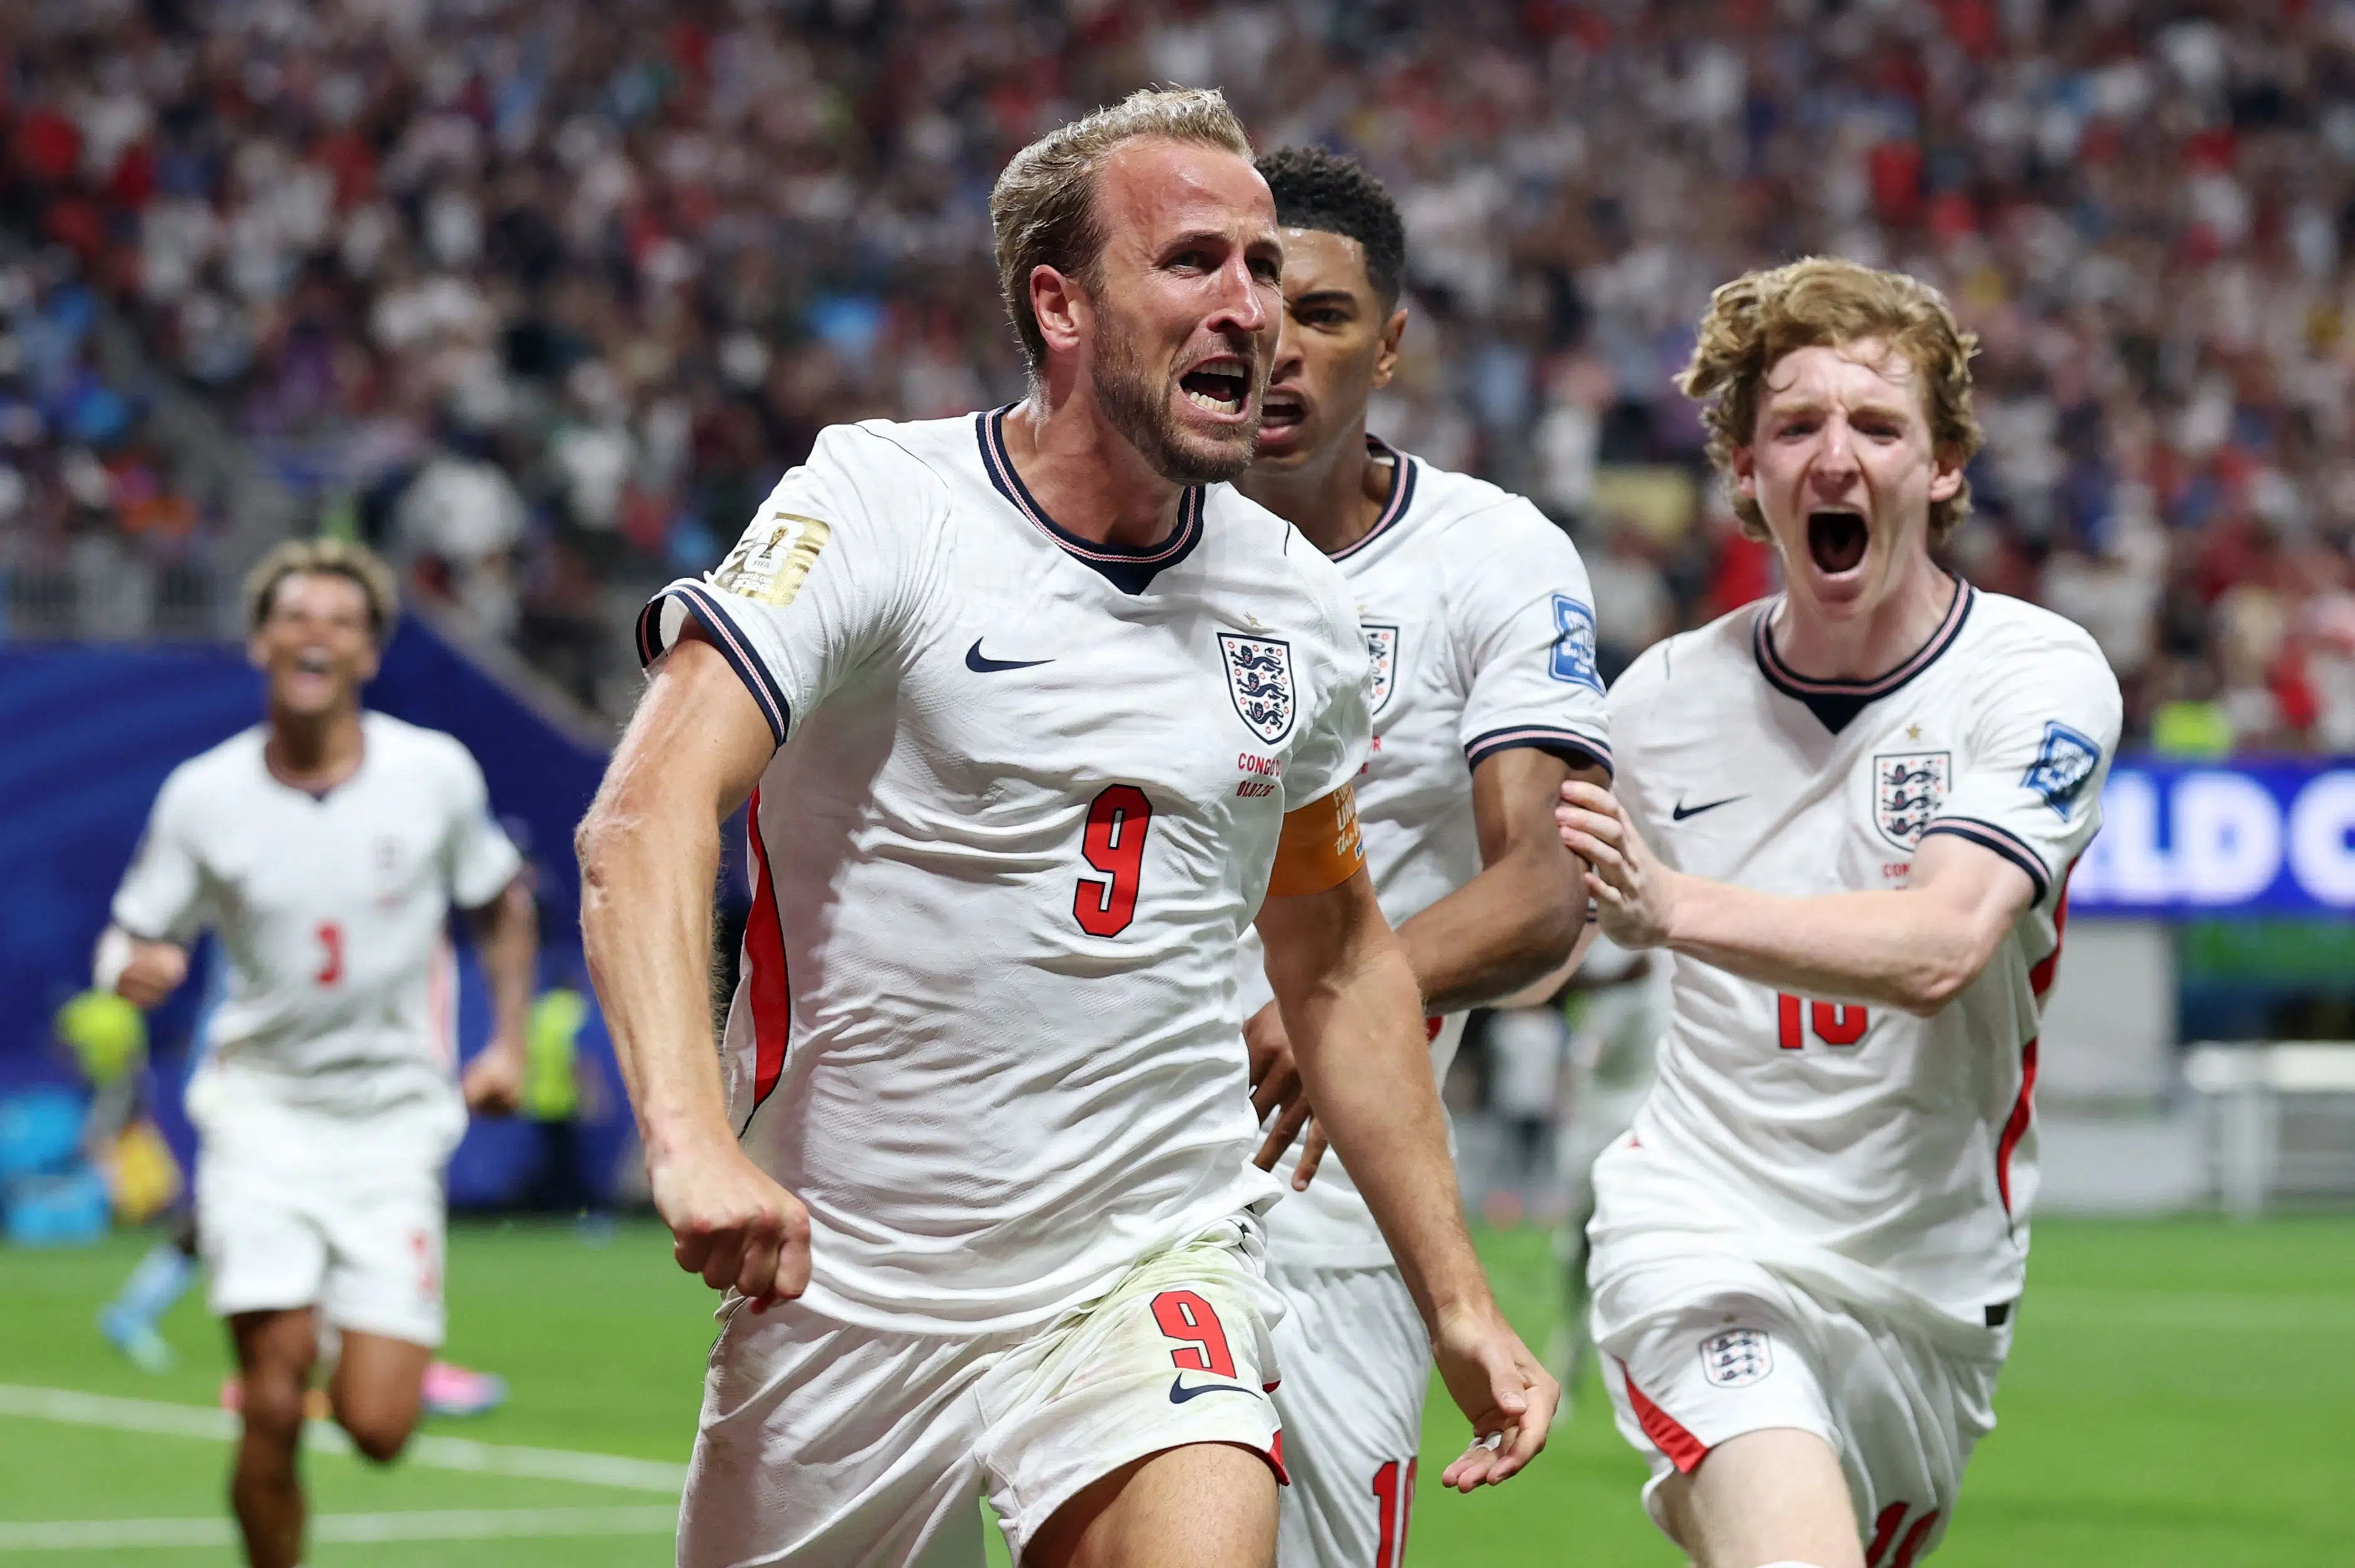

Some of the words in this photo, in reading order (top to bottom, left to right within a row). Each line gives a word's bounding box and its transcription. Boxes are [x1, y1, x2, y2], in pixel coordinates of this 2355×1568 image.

[752, 560, 770, 569] FIFA
[1238, 752, 1275, 776] CONGO
[1073, 783, 1153, 938] 9
[1150, 1290, 1237, 1379] 9
